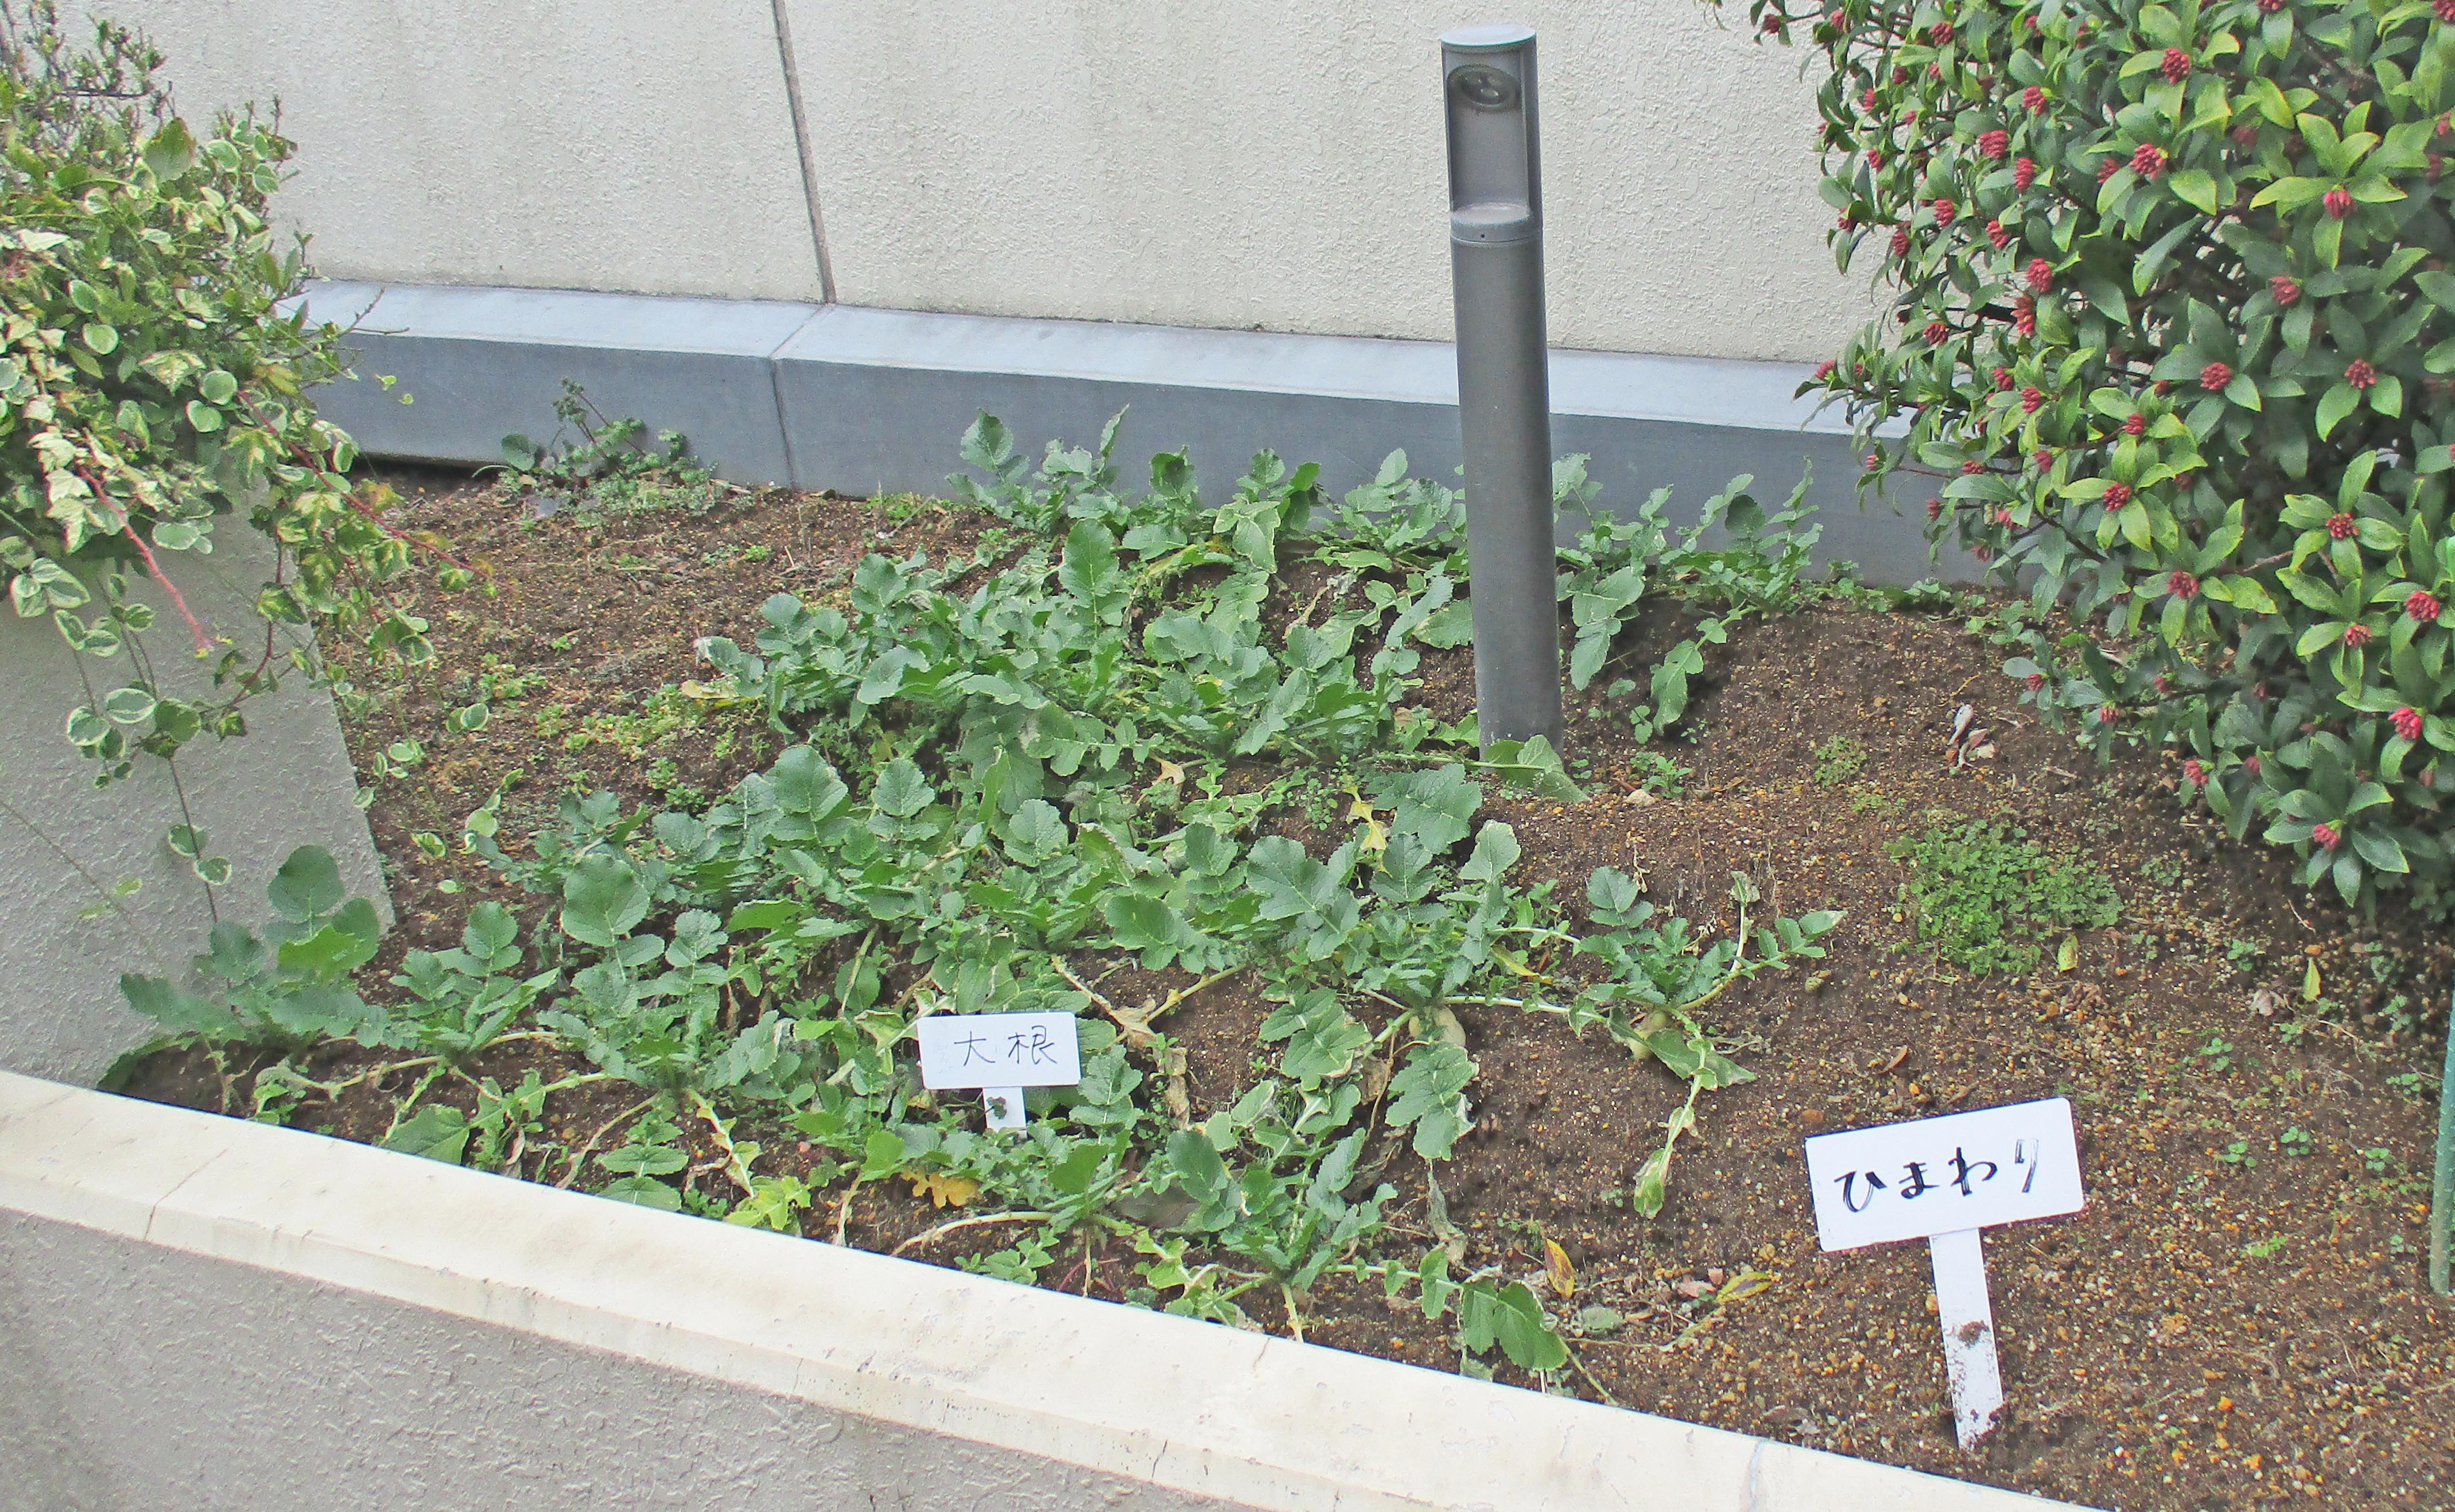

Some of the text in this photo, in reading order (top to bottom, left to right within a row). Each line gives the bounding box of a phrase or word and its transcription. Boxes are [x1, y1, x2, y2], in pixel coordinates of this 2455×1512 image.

[954, 1025, 1058, 1067] 大根
[1834, 1138, 2040, 1213] ひまわり
